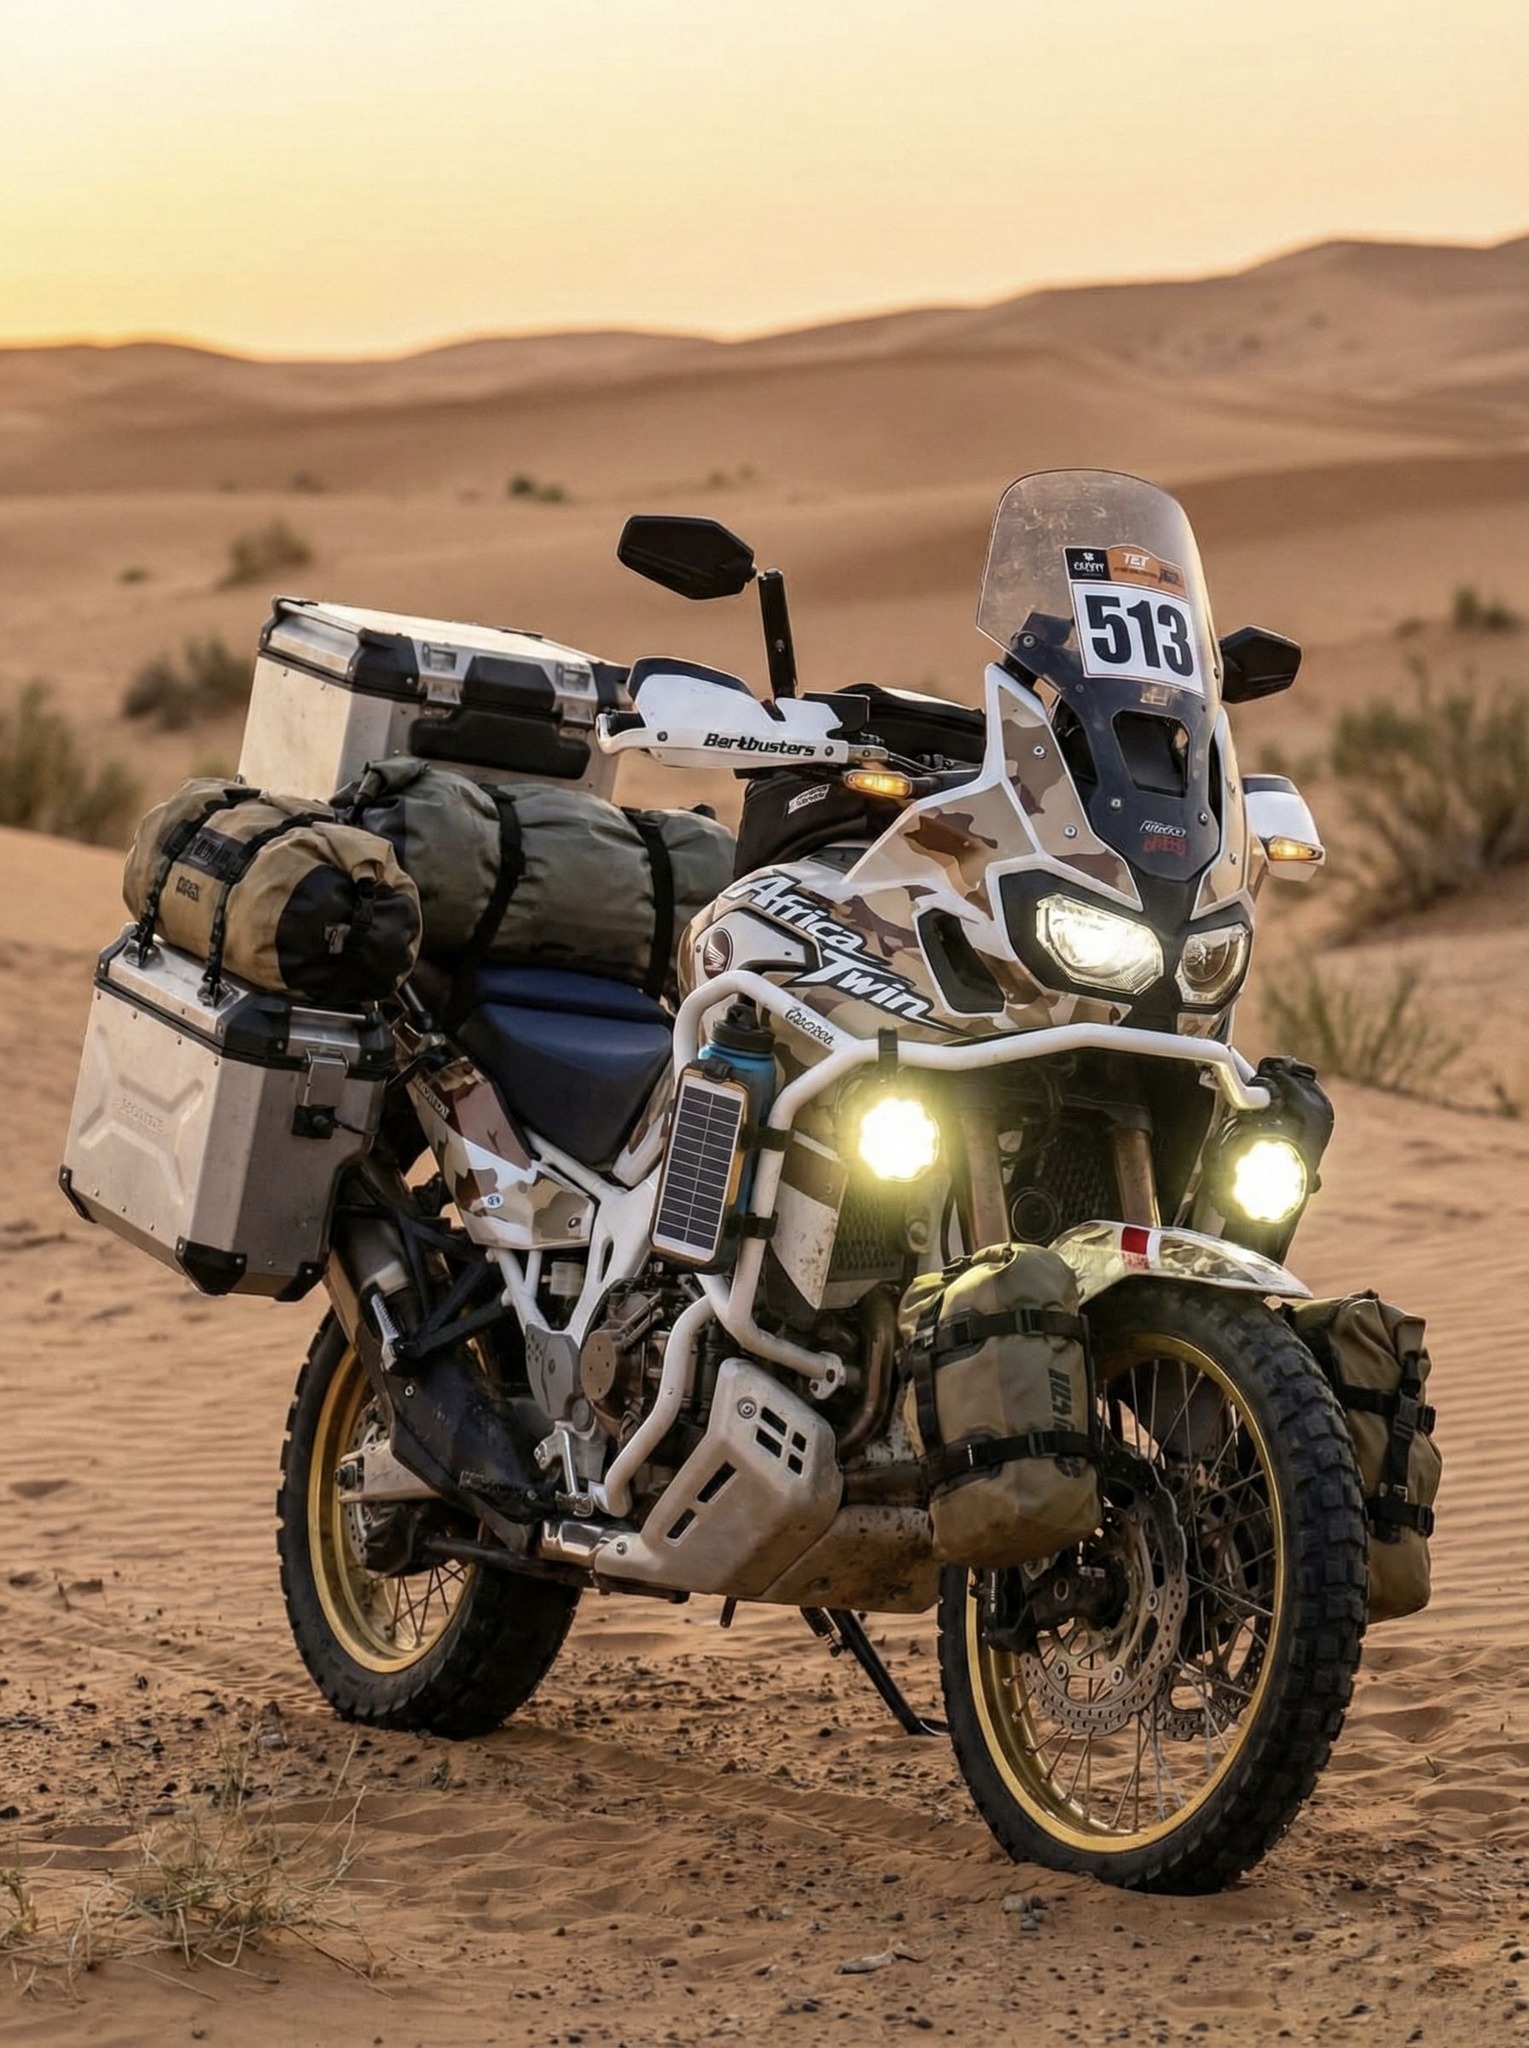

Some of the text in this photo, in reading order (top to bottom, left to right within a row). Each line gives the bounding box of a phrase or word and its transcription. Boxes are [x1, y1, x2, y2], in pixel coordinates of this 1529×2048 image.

[1085, 594, 1194, 677] 513
[723, 872, 887, 964] Africa
[794, 949, 945, 1027] Twin
